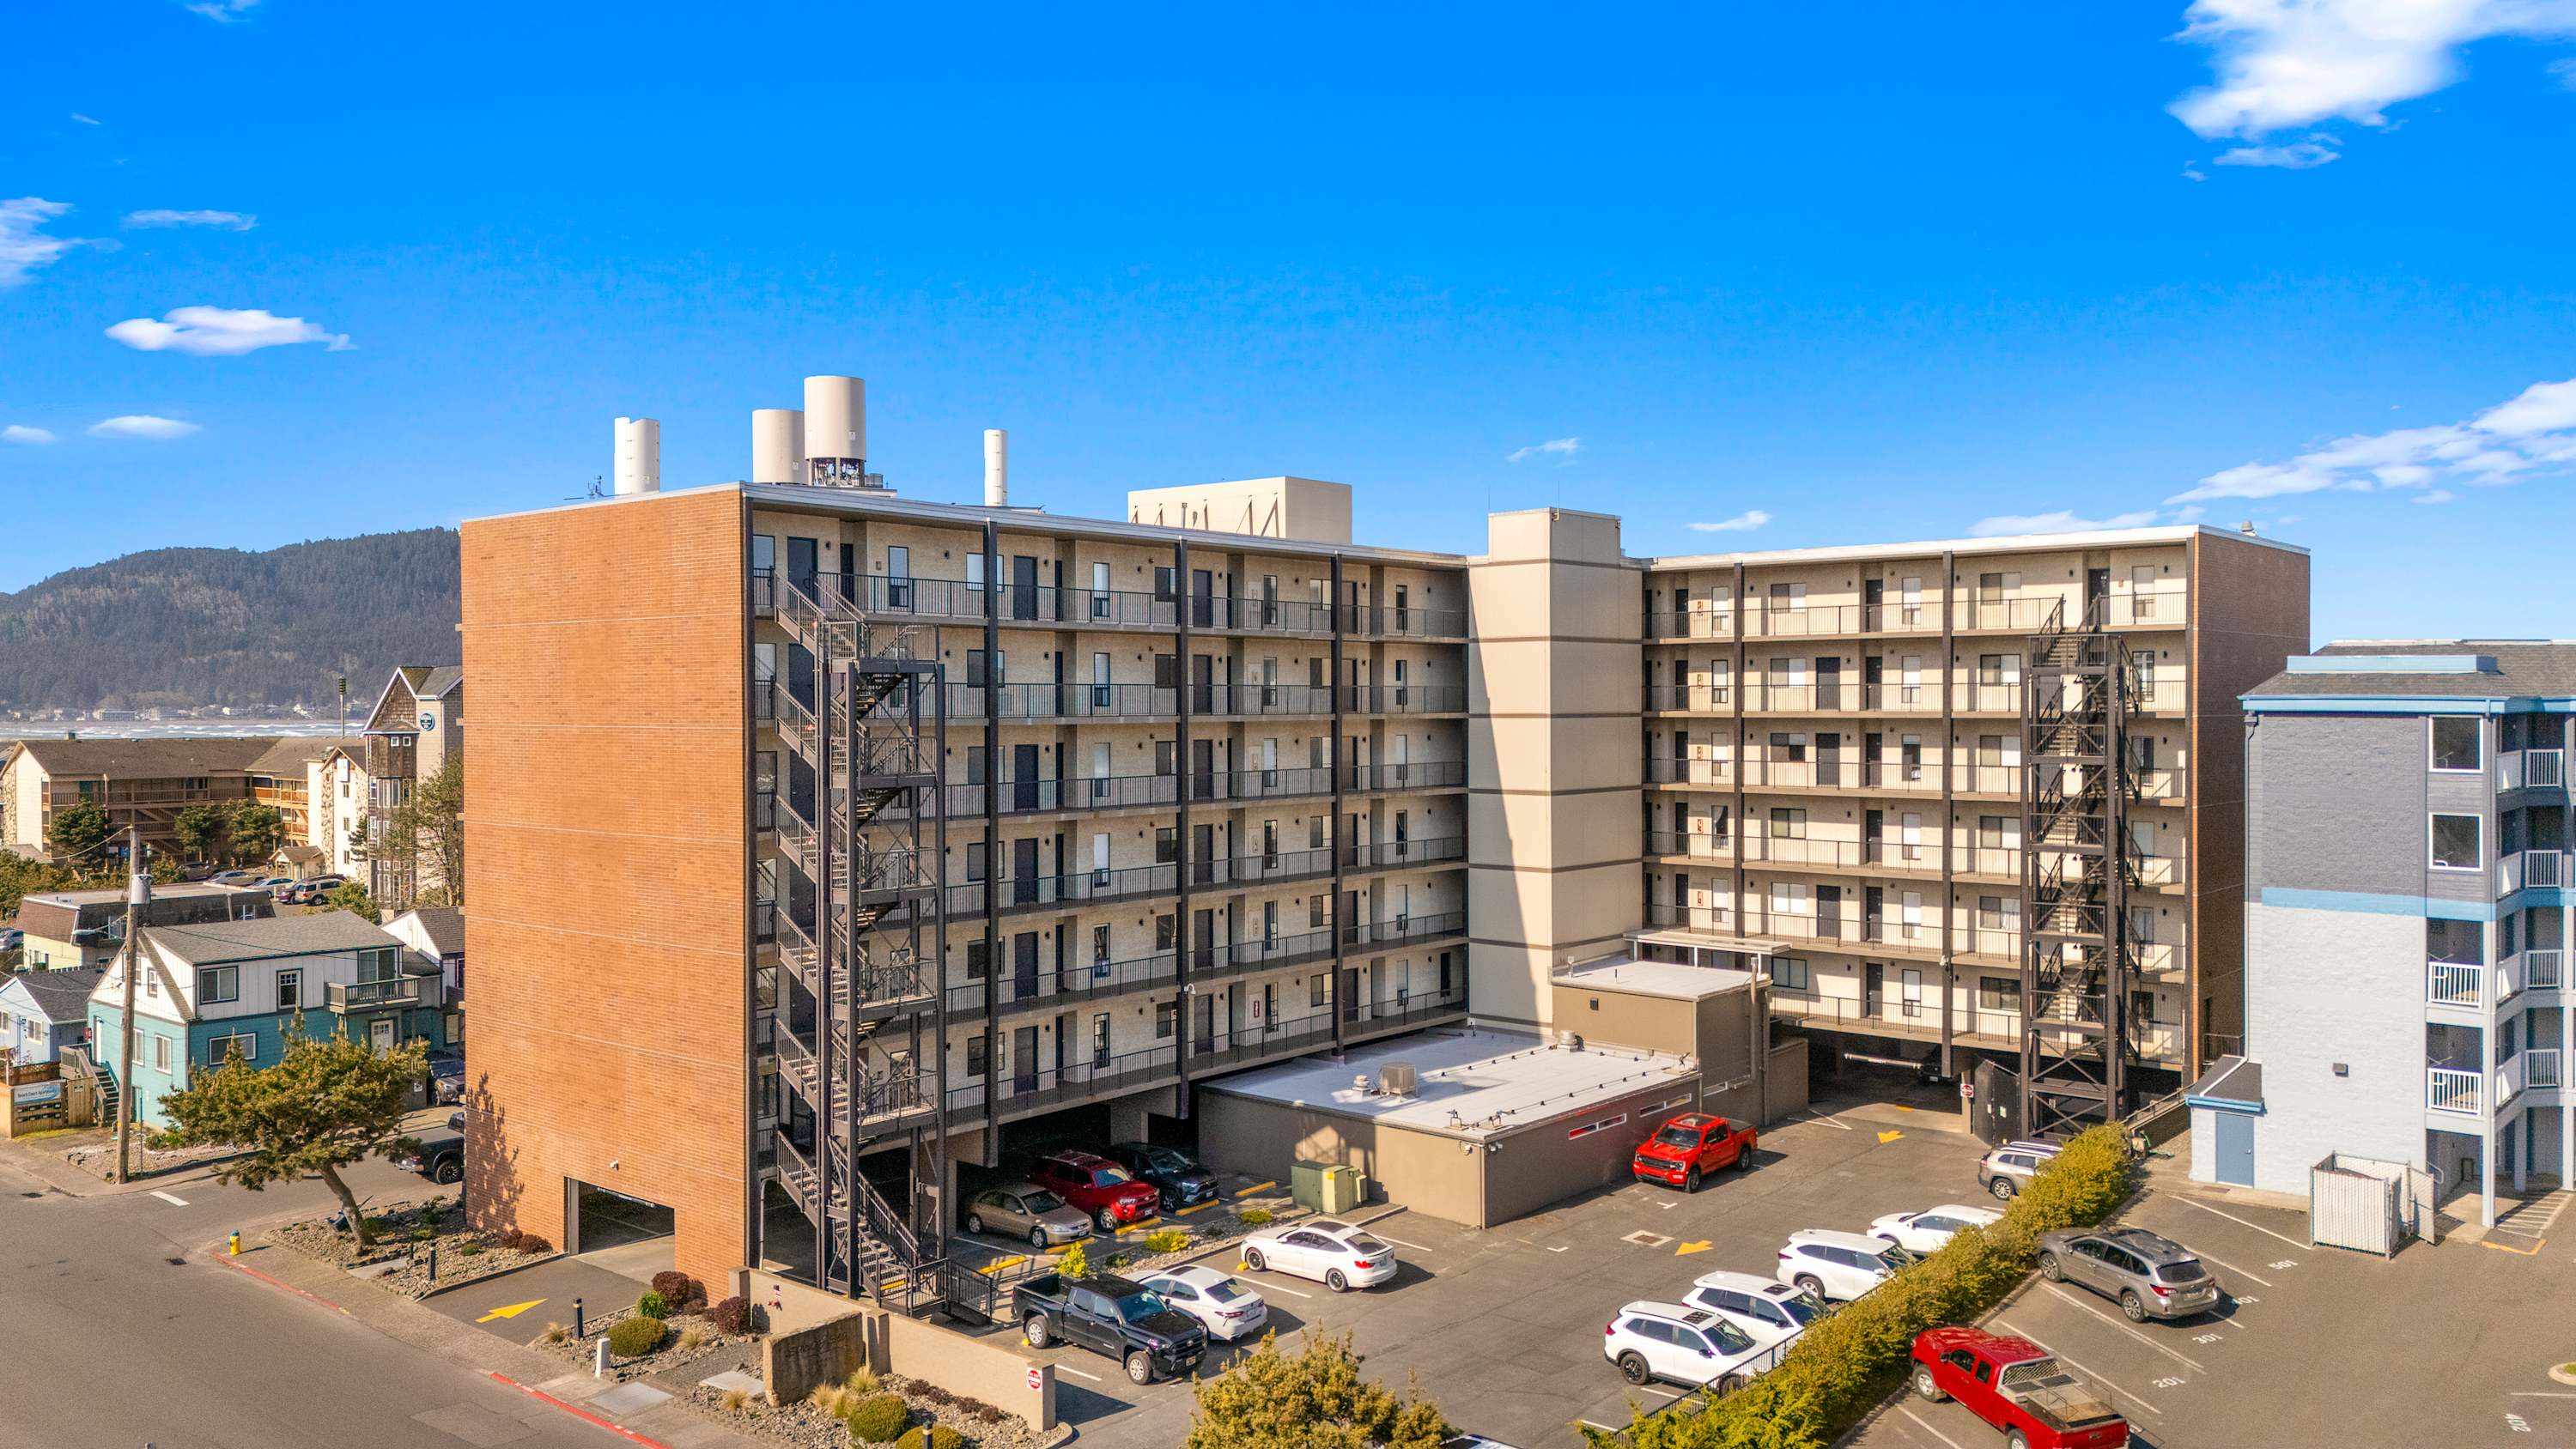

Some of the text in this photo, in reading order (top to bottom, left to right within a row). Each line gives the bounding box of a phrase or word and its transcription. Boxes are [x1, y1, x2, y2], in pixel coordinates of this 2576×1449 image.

[2267, 1259, 2299, 1270] 501
[2192, 1333, 2224, 1344] 301
[2152, 1376, 2185, 1388] 201
[2504, 1413, 2531, 1433] 402
